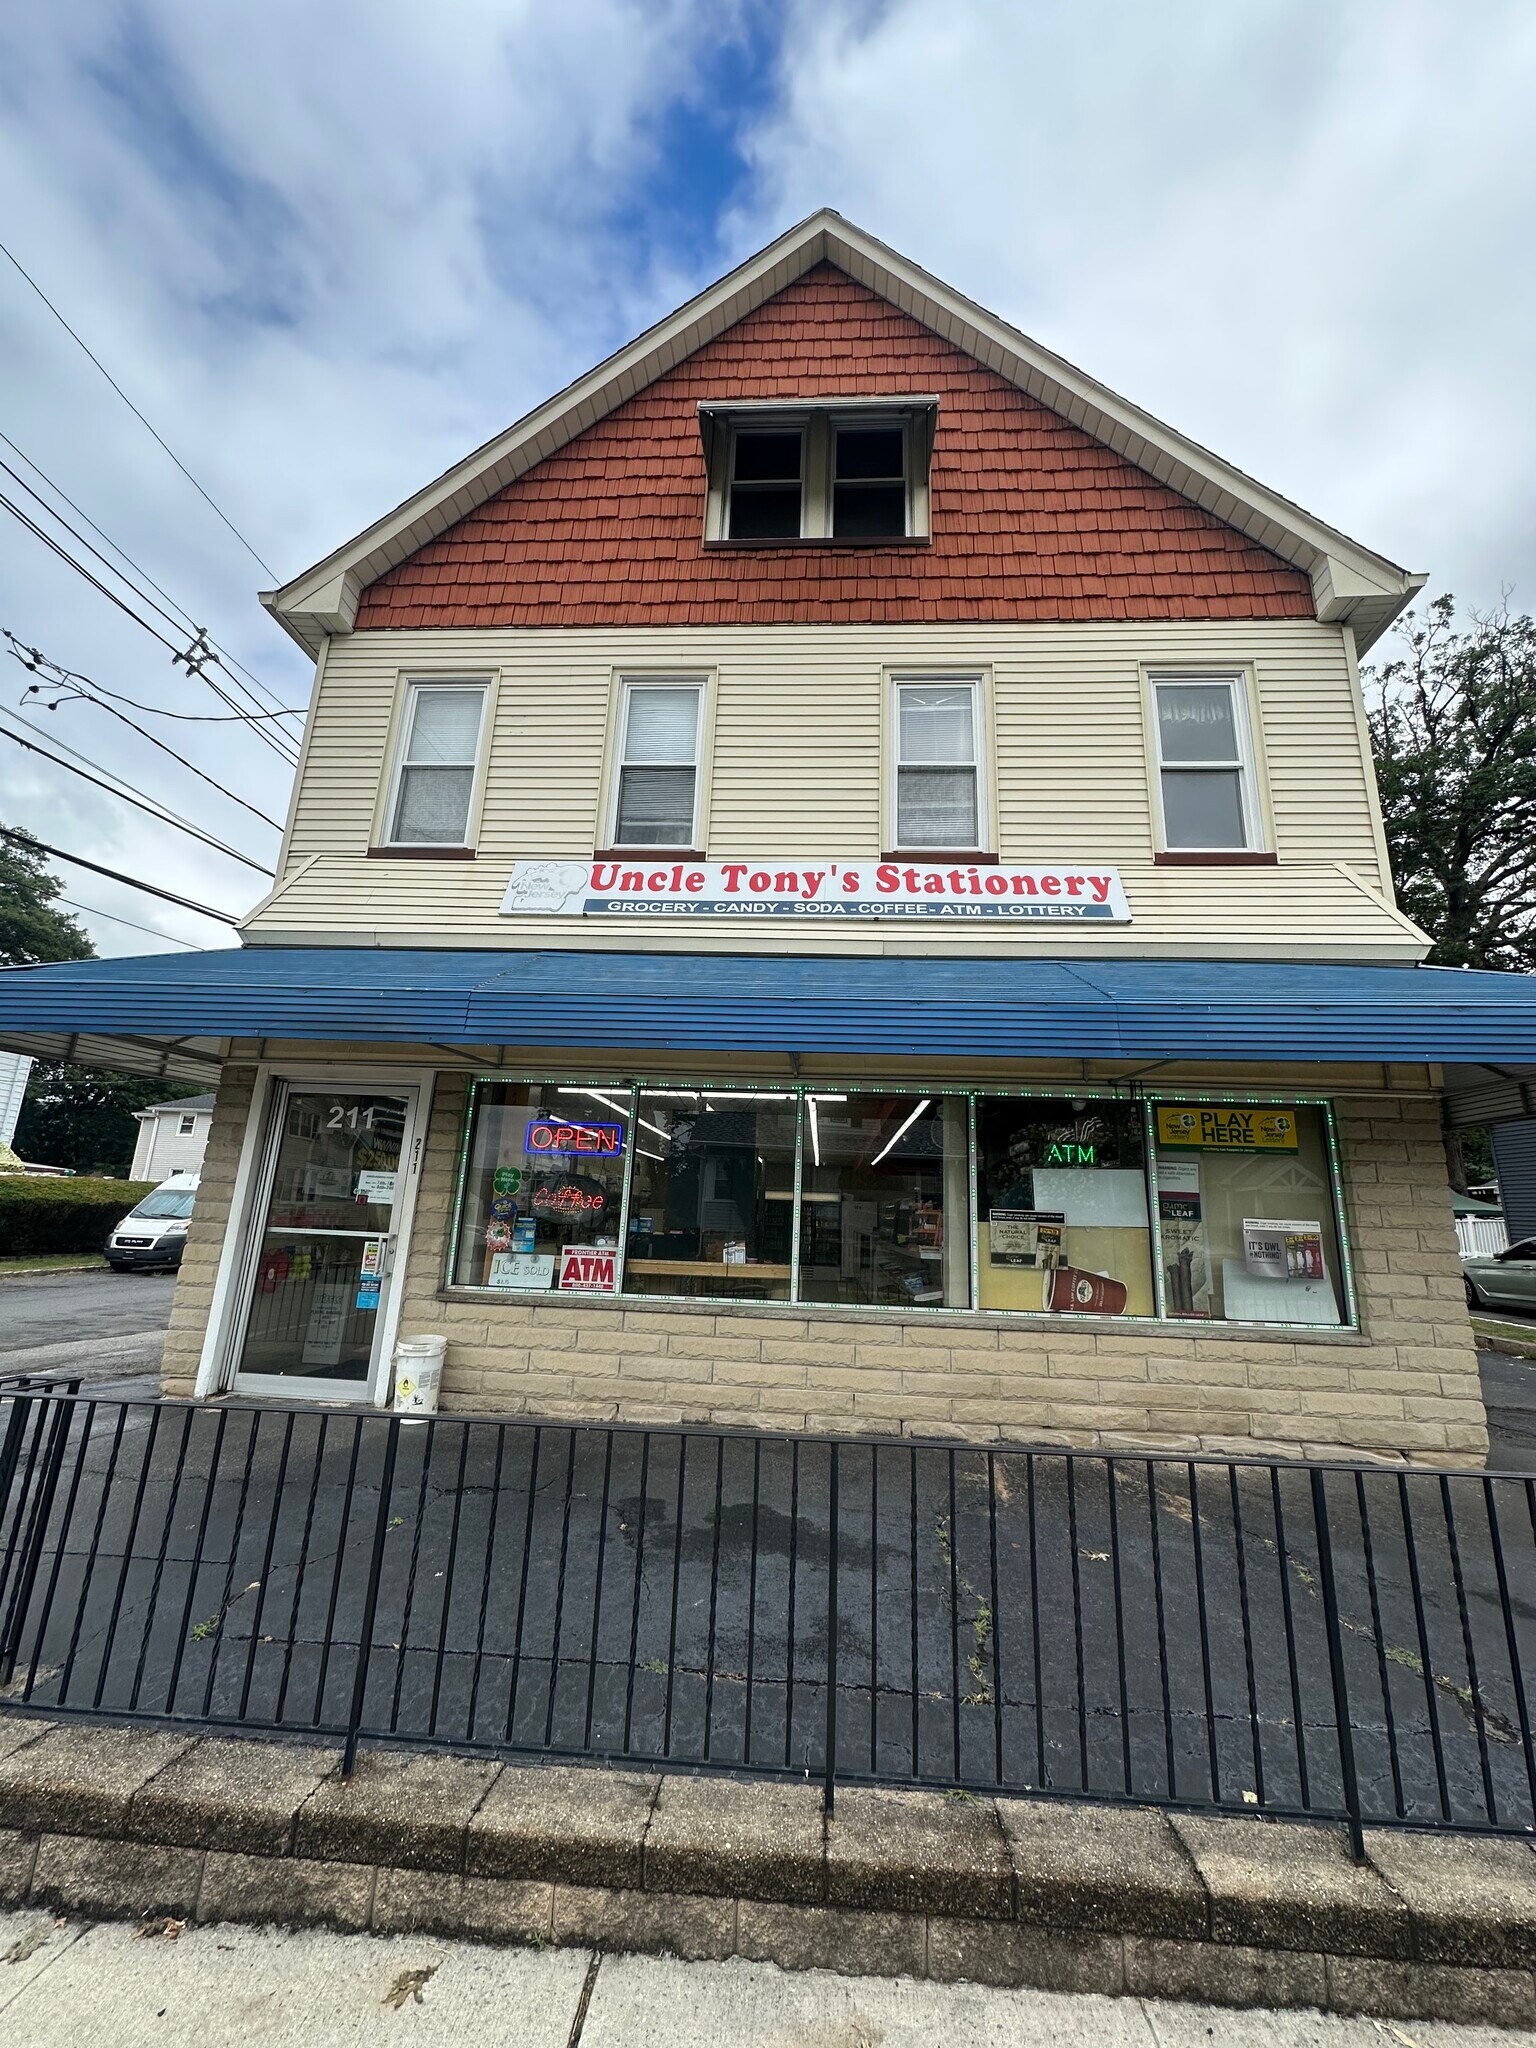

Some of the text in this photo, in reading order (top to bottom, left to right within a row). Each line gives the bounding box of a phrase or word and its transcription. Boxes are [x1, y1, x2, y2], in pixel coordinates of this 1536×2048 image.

[520, 882, 549, 890] New
[590, 864, 1112, 903] Uncle Tony's Stationery
[525, 889, 563, 899] Jersey
[607, 902, 701, 912] GROCERY
[714, 902, 779, 913] CANDY
[793, 903, 846, 914] SODA
[940, 904, 982, 915] ATM
[998, 905, 1087, 916] LOTTERY
[326, 1106, 374, 1129] 211
[1200, 1112, 1253, 1129] PLAY
[532, 1126, 615, 1150] OPEN
[1167, 1134, 1190, 1142] Lottery
[1170, 1128, 1190, 1136] Jersey
[1202, 1128, 1255, 1143] HERE
[412, 1138, 422, 1175] 211
[1047, 1144, 1094, 1163] ATM
[533, 1188, 604, 1210] Coffee
[1162, 1202, 1188, 1213] game
[1249, 1241, 1263, 1251] IT'S
[1264, 1242, 1281, 1252] OWL
[493, 1259, 550, 1277] ICE SOLD
[561, 1257, 614, 1283] ATM
